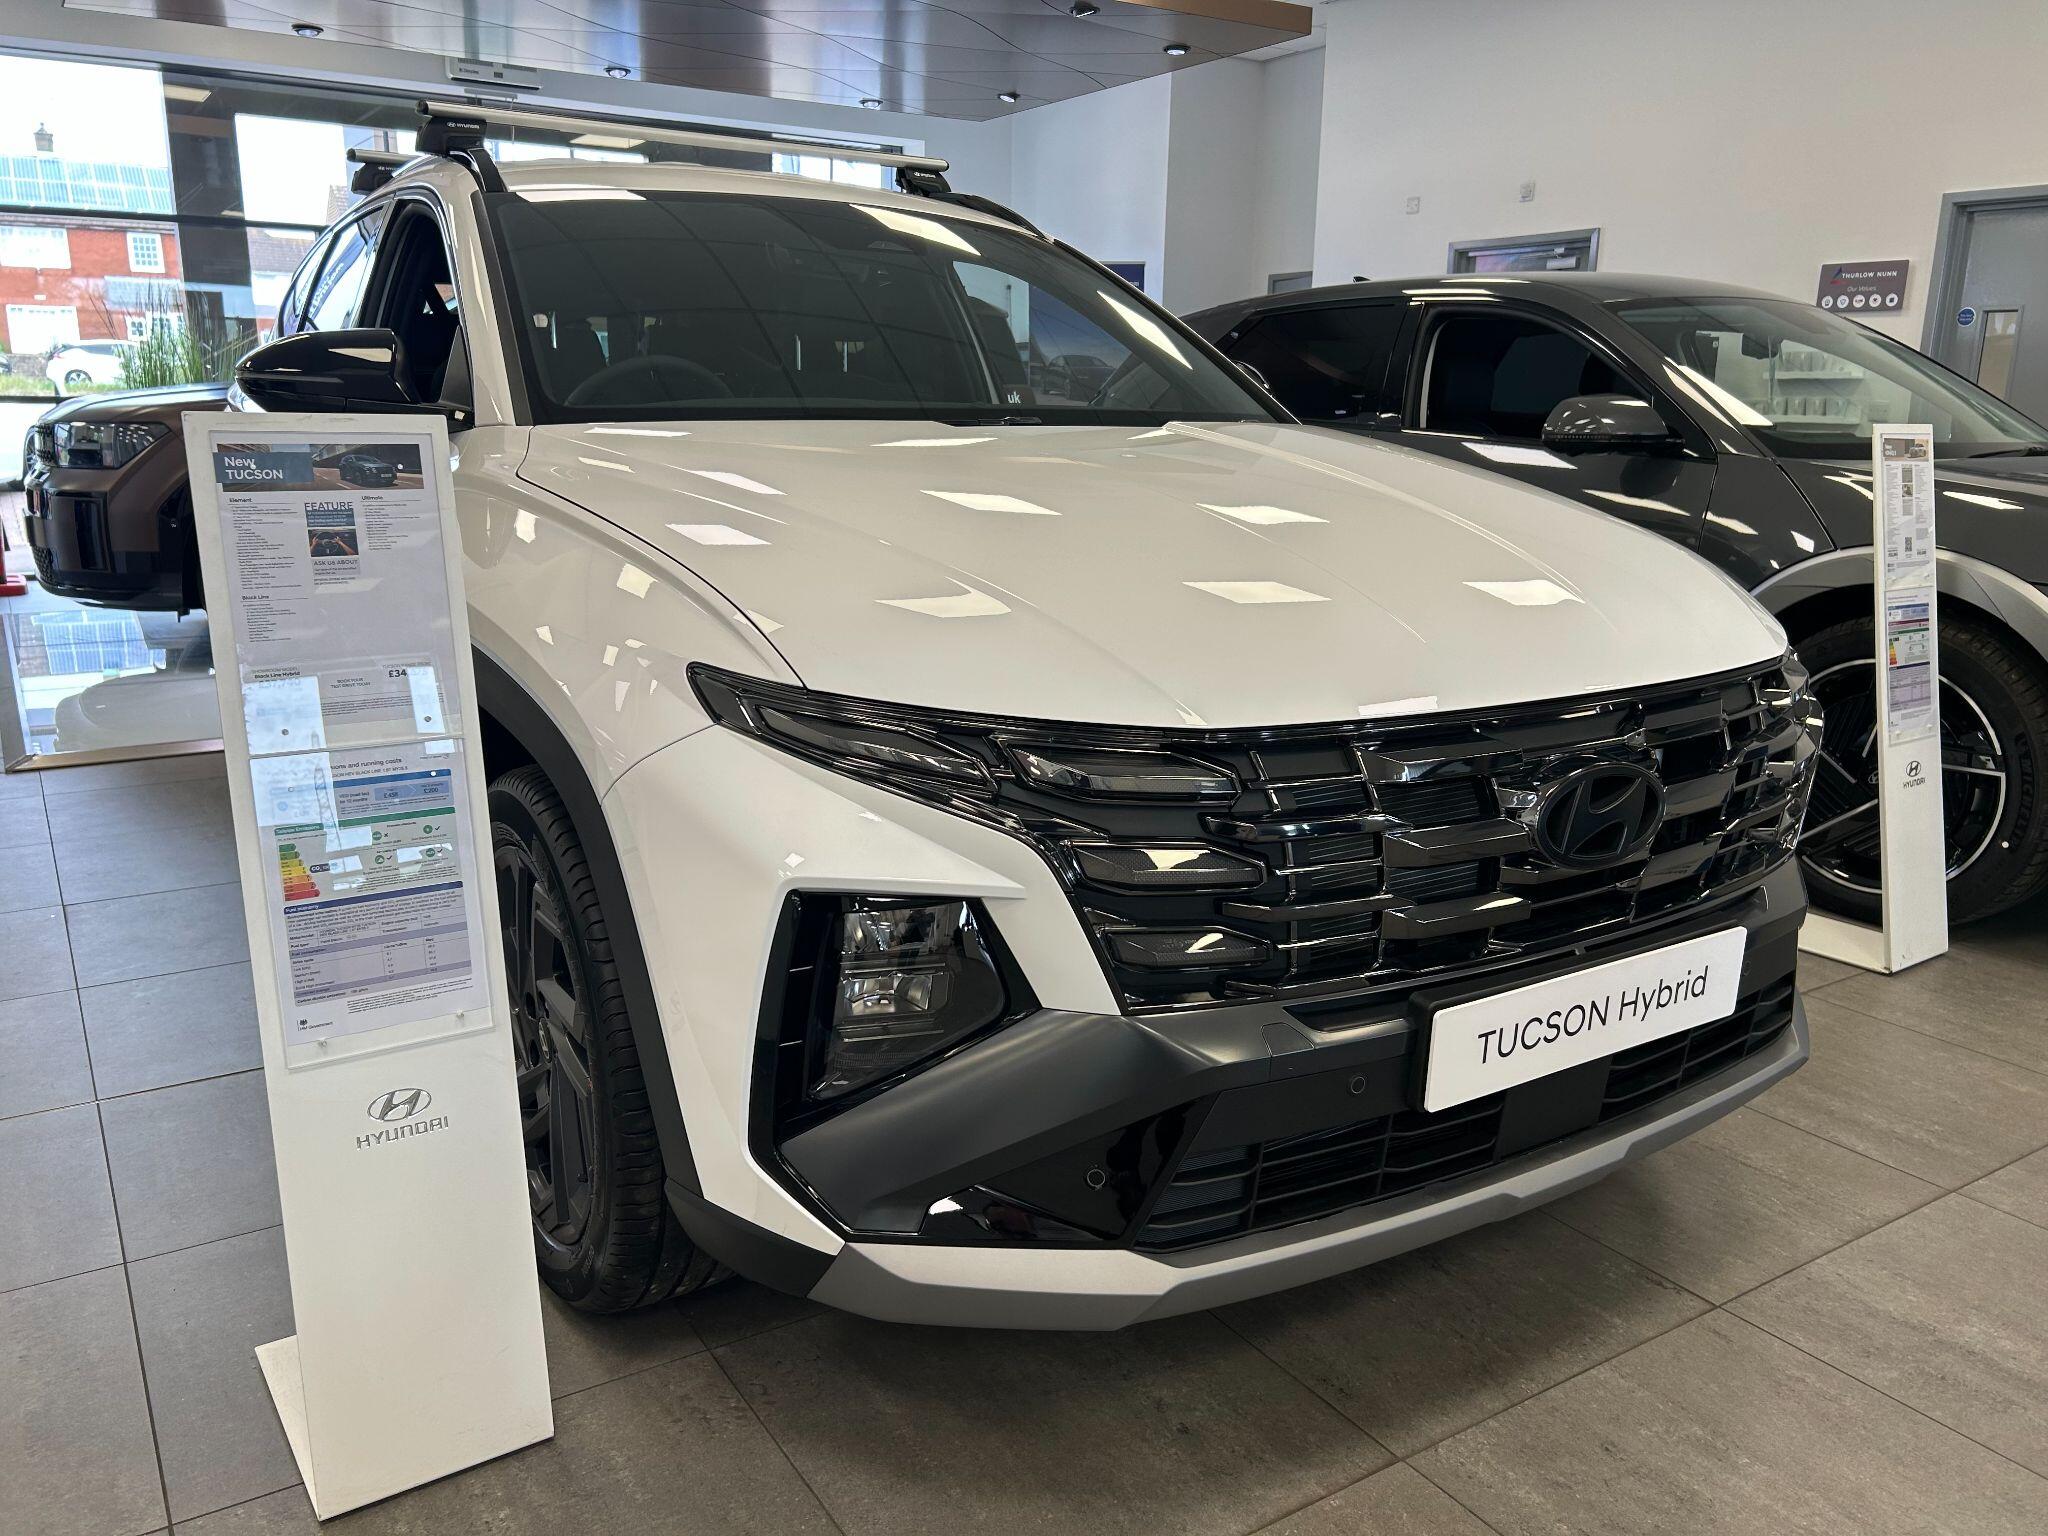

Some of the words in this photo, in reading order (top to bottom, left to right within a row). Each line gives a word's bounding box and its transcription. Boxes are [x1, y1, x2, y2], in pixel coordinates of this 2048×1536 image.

[1841, 271, 1875, 279] THURLOW
[1007, 391, 1021, 404] uk
[223, 456, 255, 468] New
[225, 469, 284, 480] TUCSON
[304, 501, 354, 511] FEATURE
[347, 761, 360, 769] and
[360, 758, 385, 767] running
[384, 756, 403, 765] costs
[1902, 777, 1927, 790] HYUNDAI
[1477, 995, 1611, 1065] TUCSON
[1618, 965, 1709, 1022] Hybrid
[356, 1115, 450, 1151] HYUNDAI
